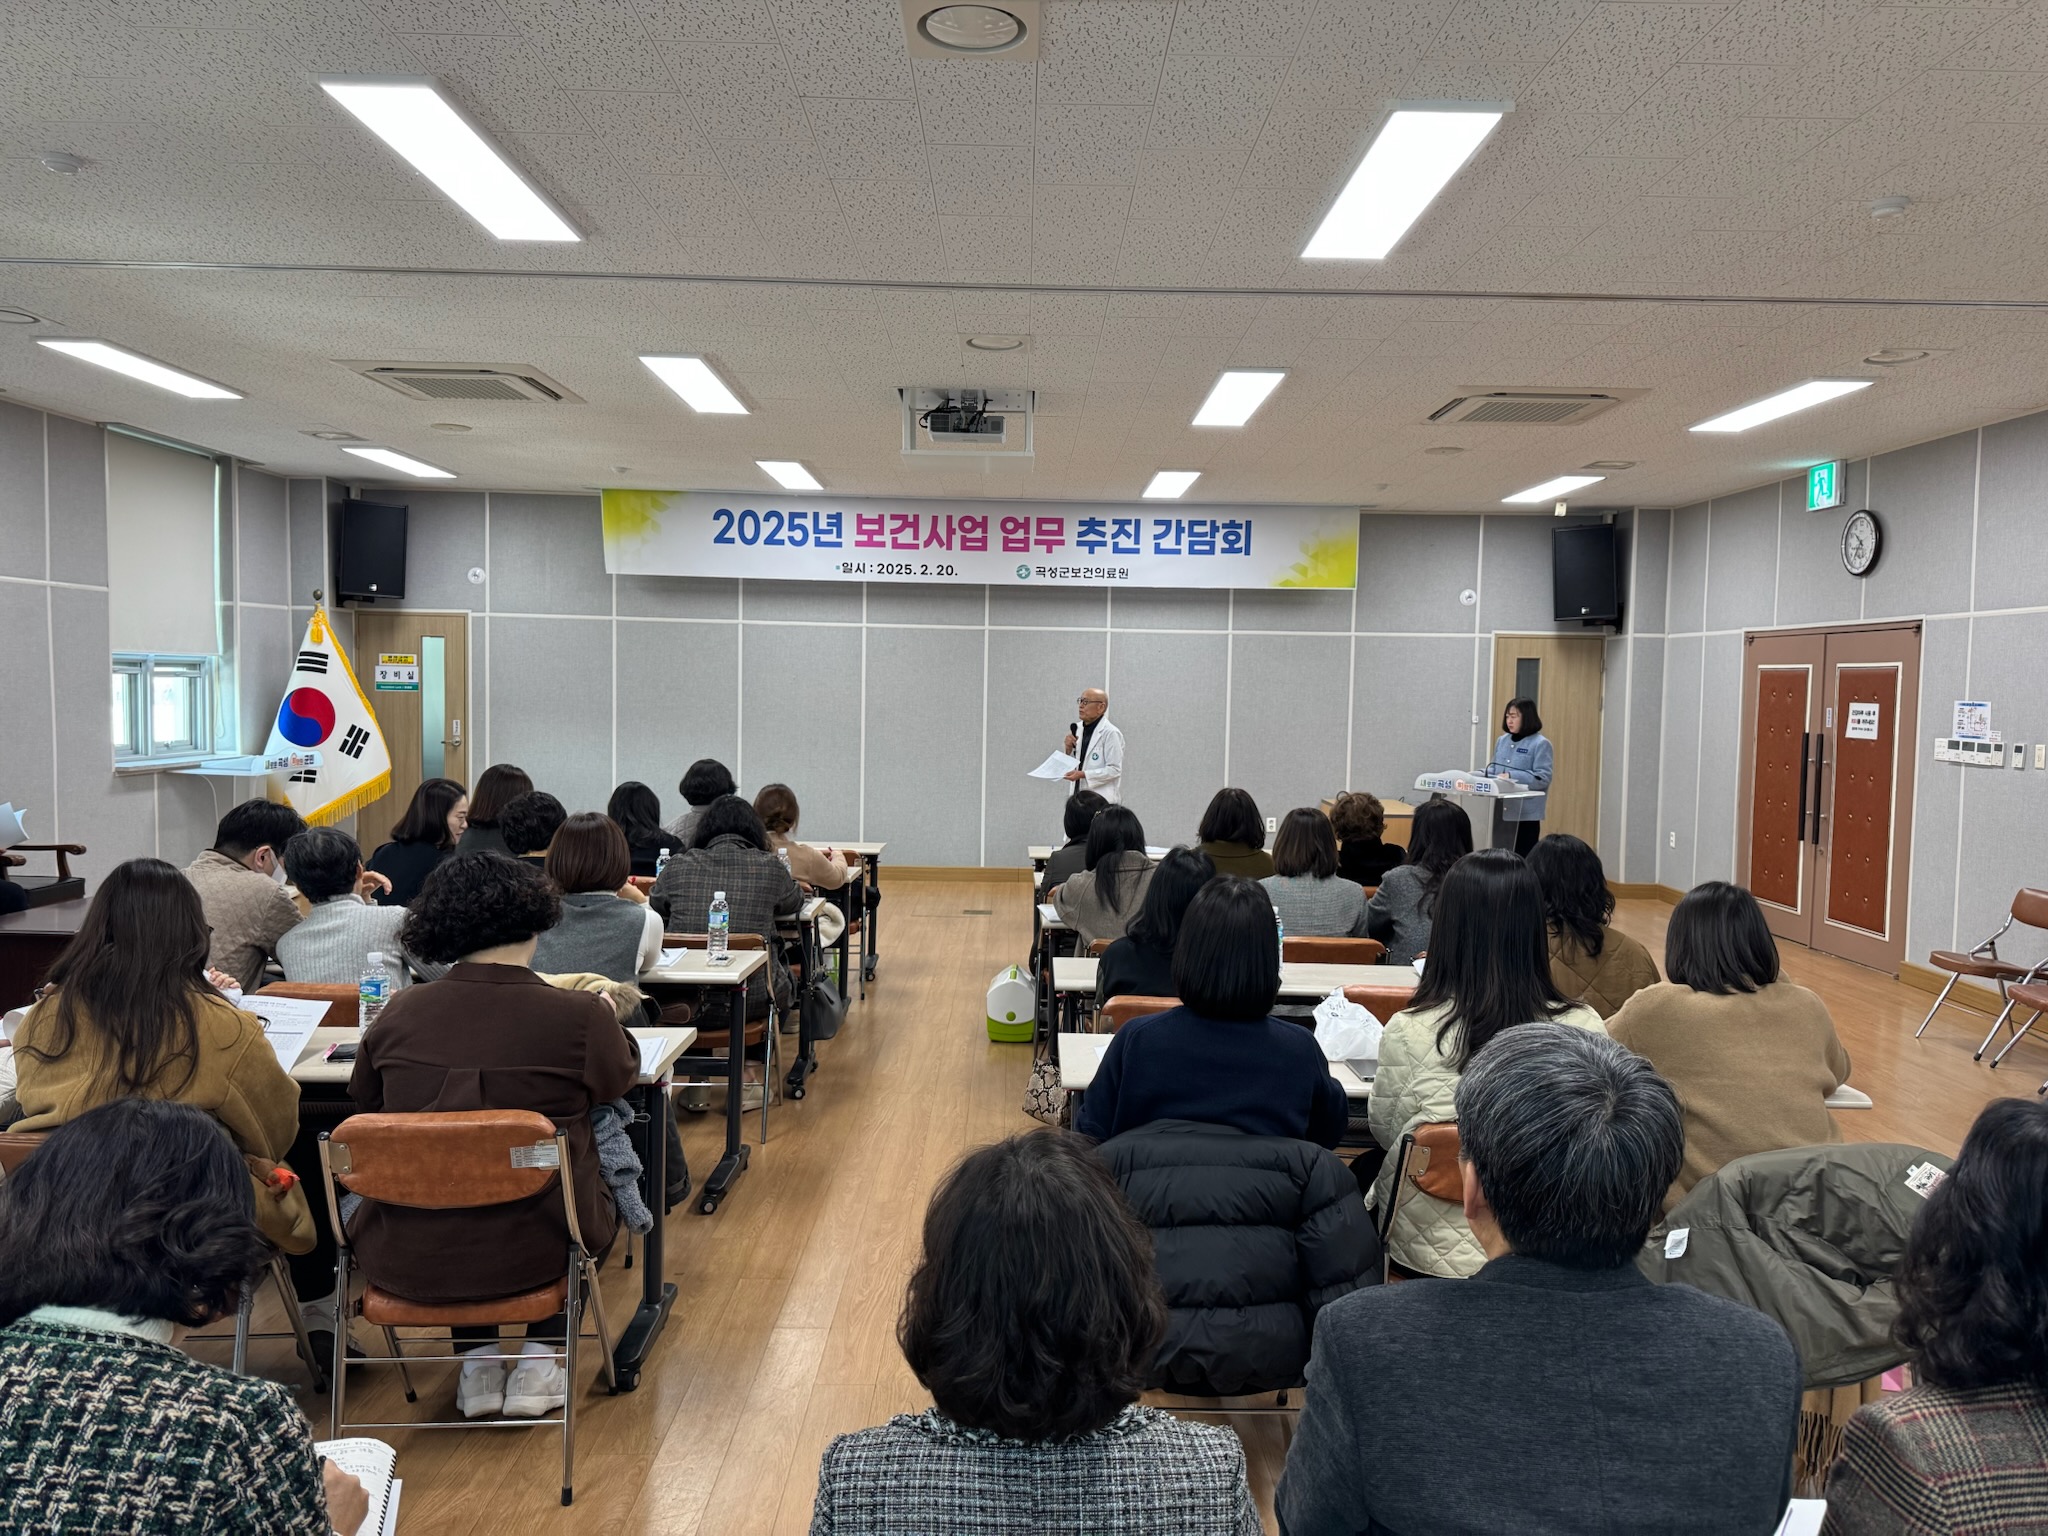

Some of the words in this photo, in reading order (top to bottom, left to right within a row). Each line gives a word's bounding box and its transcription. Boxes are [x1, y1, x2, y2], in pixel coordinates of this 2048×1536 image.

[712, 508, 843, 548] 2025년
[854, 513, 989, 552] 보건사업
[999, 516, 1066, 554] 업무
[1076, 517, 1141, 555] 추진
[1153, 519, 1252, 556] 간담회
[1035, 565, 1129, 580] 곡성군보건의료원
[1438, 779, 1452, 789] 곡성
[1476, 782, 1491, 793] 군민
